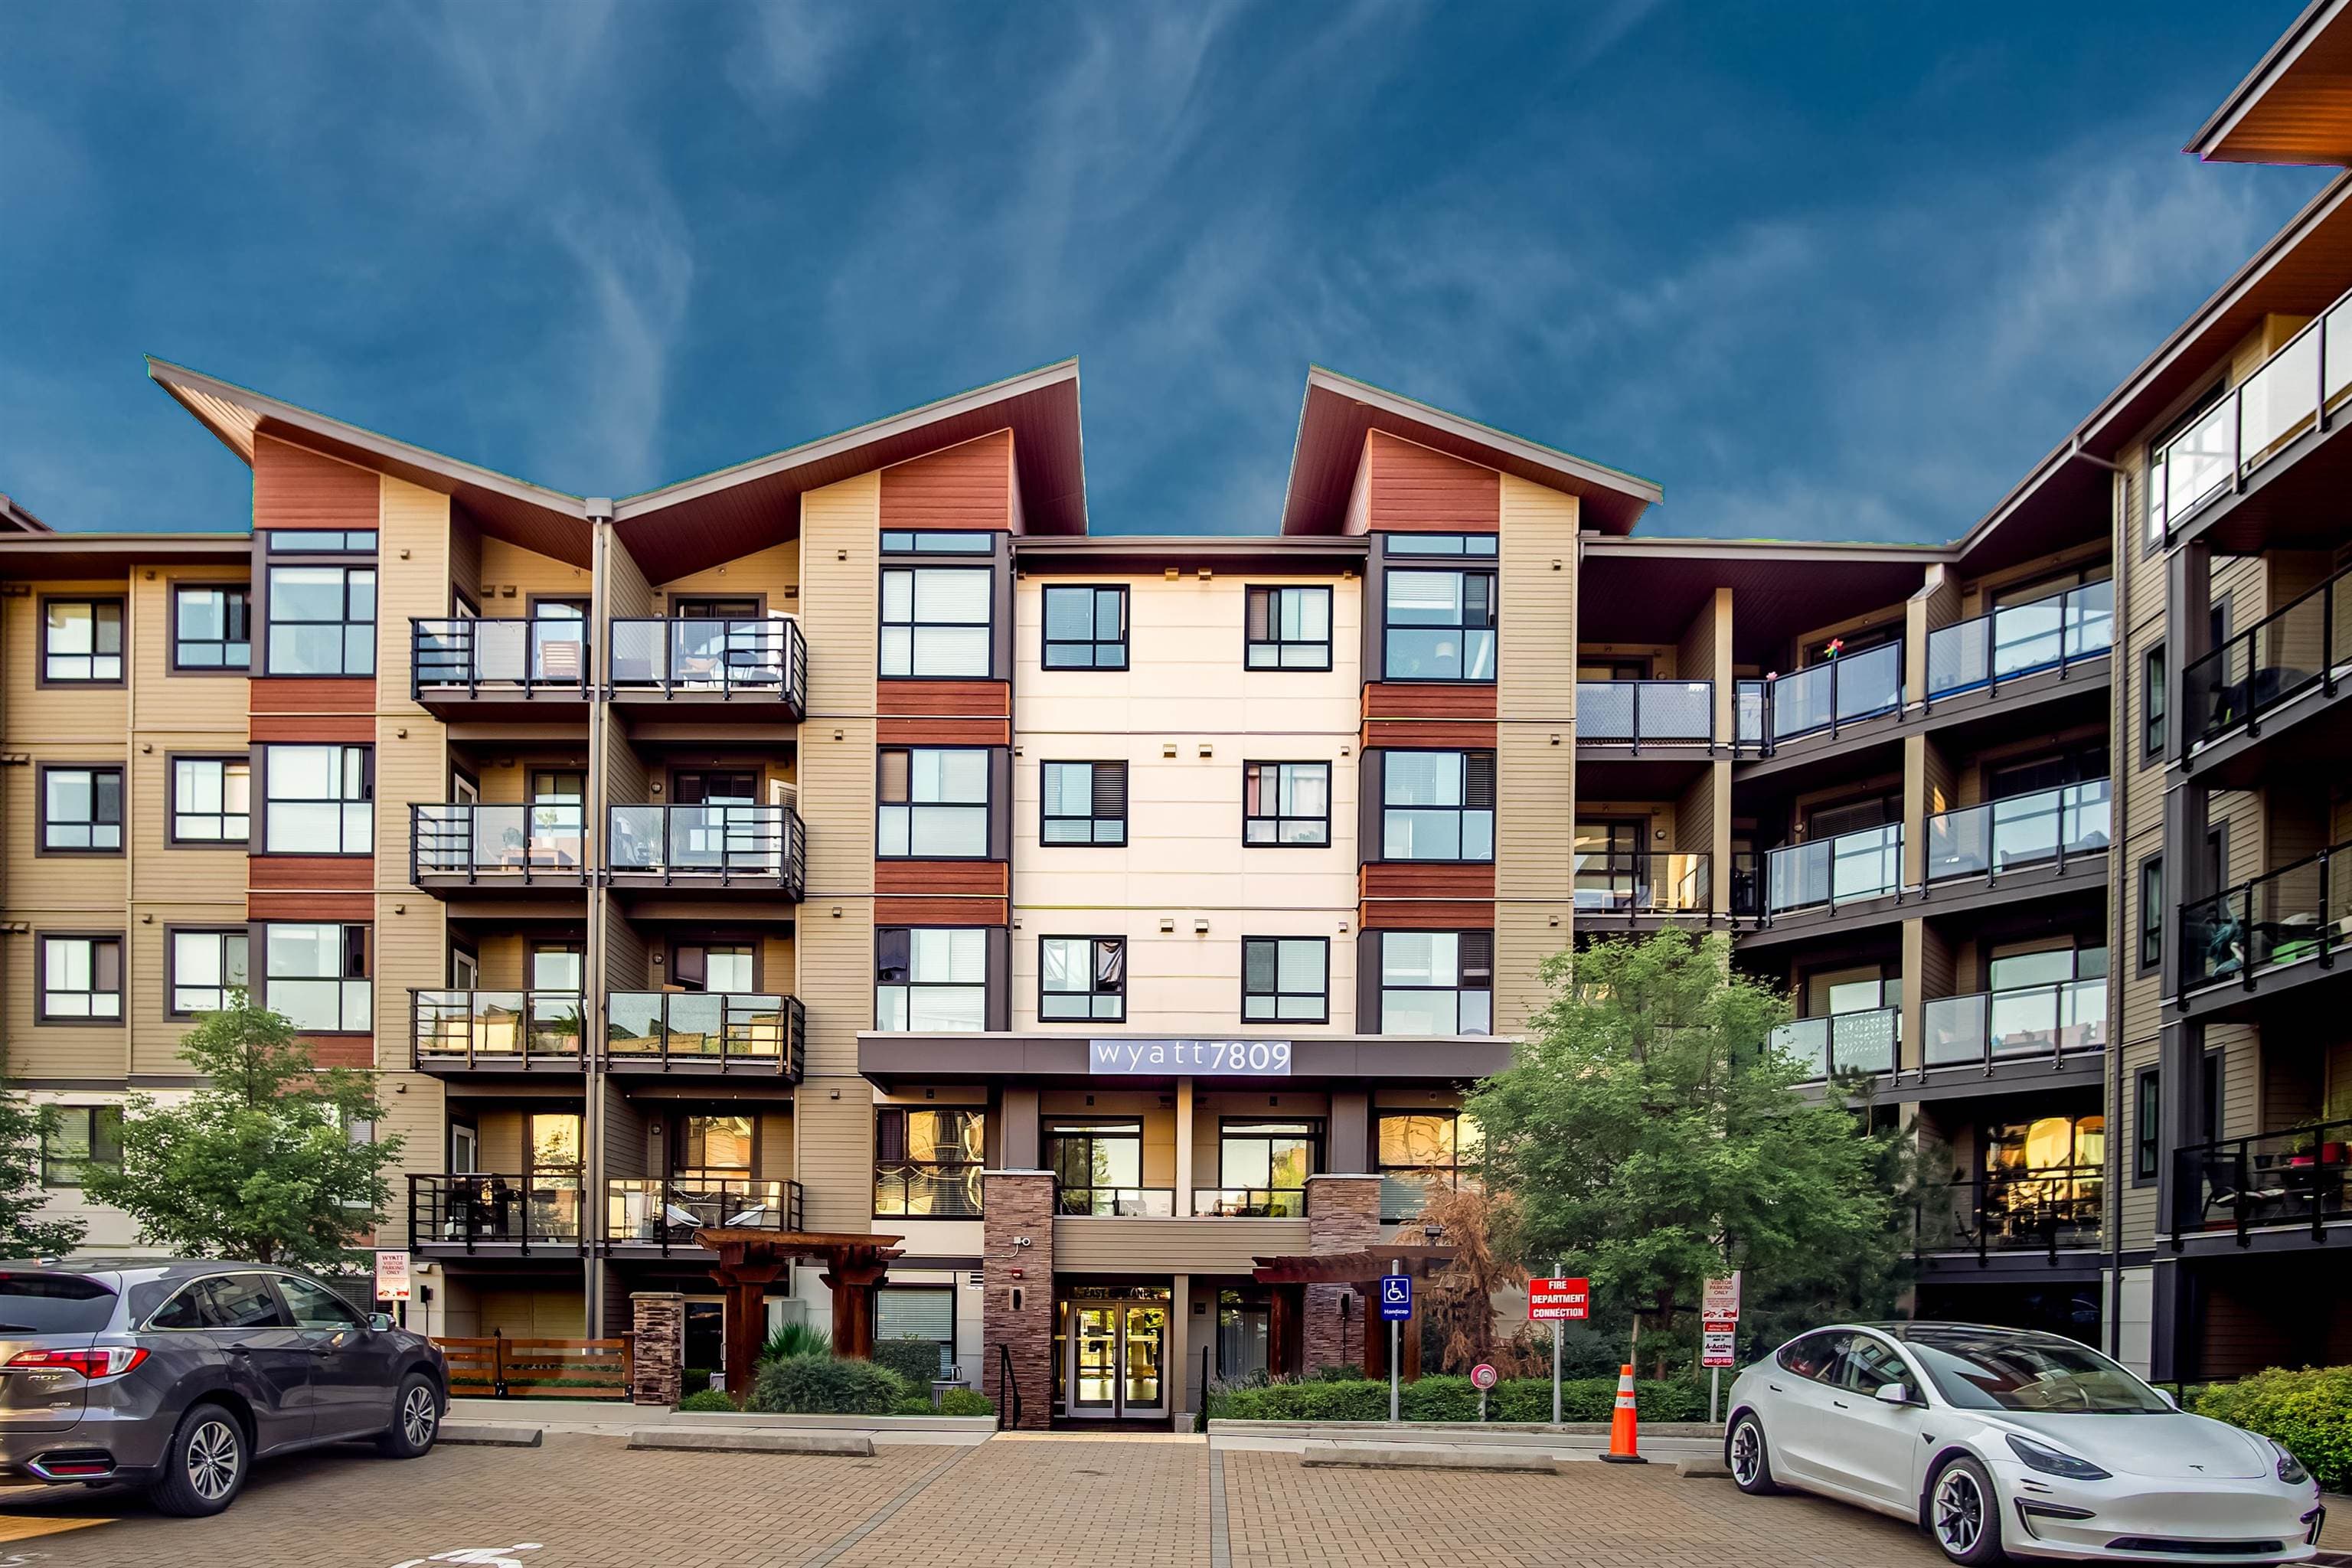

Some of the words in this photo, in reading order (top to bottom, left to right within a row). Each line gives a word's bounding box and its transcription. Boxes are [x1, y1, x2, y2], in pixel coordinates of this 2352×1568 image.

[1097, 1041, 1203, 1071] wyatt
[1210, 1042, 1289, 1071] 7809
[1548, 1281, 1567, 1289] FIRE
[1084, 1289, 1104, 1297] EAST
[1532, 1294, 1585, 1304] DEPARTMENT
[1533, 1308, 1583, 1318] CONNECTION
